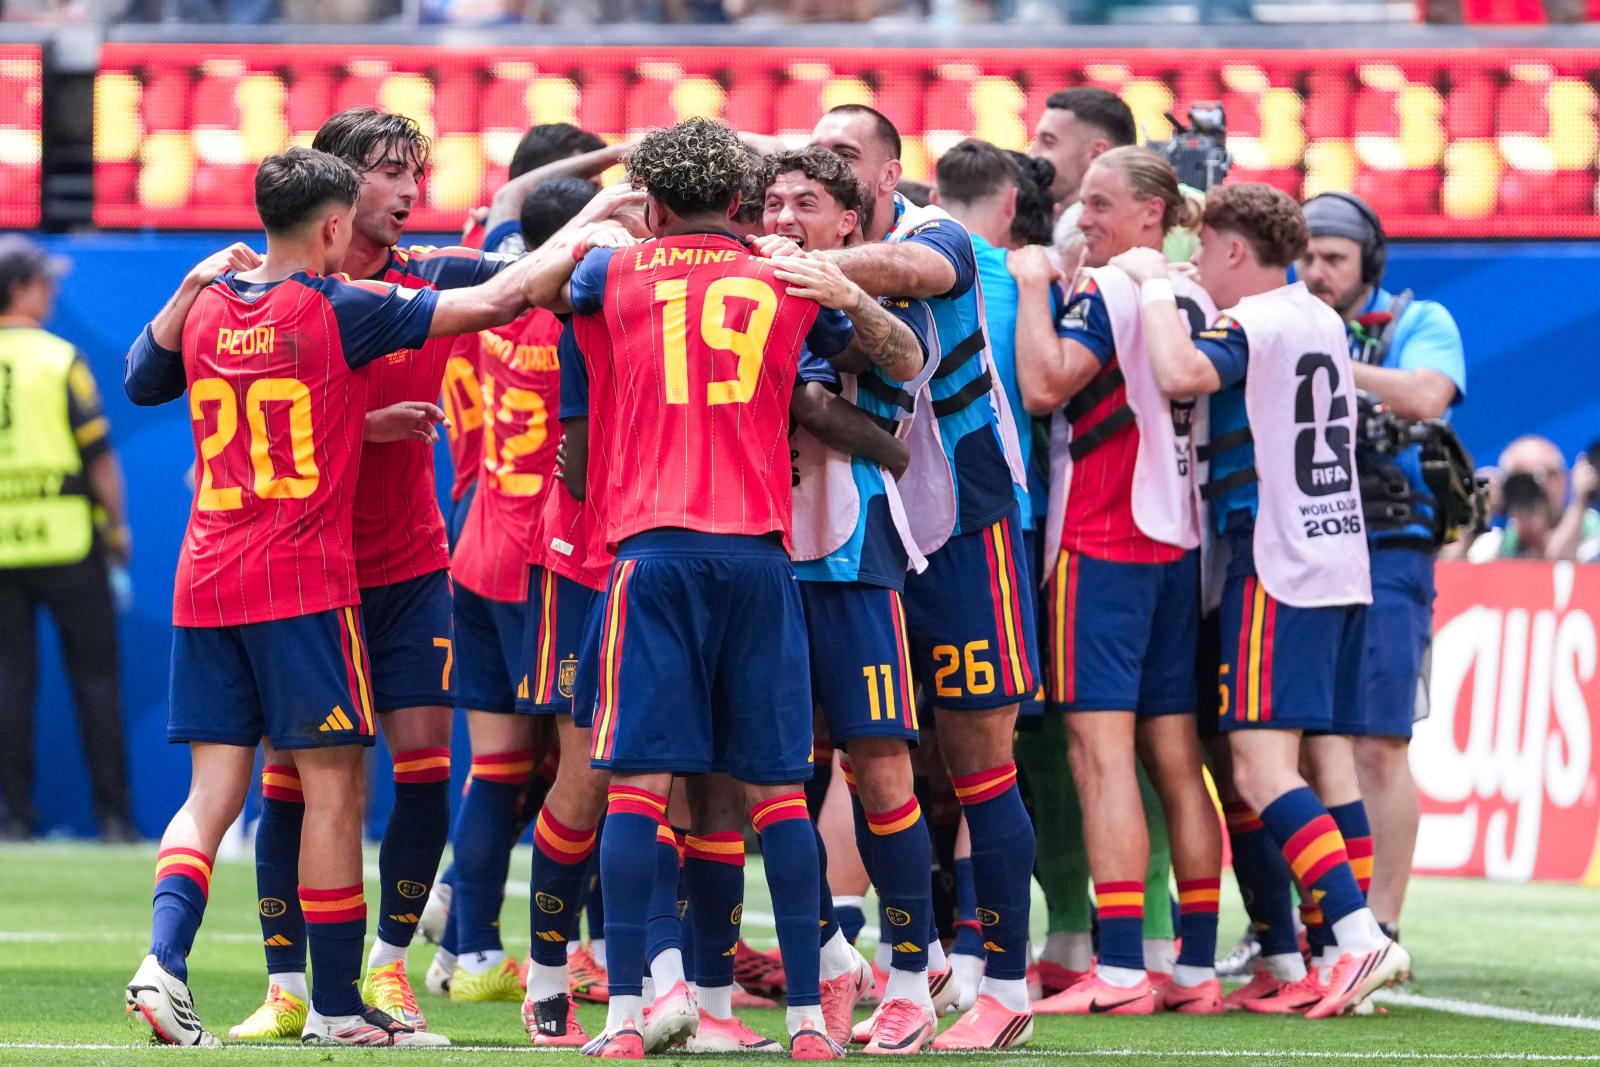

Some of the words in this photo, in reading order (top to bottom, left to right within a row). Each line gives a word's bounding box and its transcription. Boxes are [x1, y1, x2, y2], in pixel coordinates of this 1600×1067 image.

[634, 247, 737, 272] LAMINE
[216, 326, 276, 355] PEDRI
[655, 276, 778, 406] 19
[190, 377, 321, 511] 20
[480, 371, 548, 498] 12
[1312, 464, 1349, 486] FIFA
[1298, 500, 1345, 517] WORLD
[1304, 514, 1361, 538] 2026
[432, 637, 453, 691] 7
[933, 640, 996, 697] 26
[863, 664, 896, 720] 11
